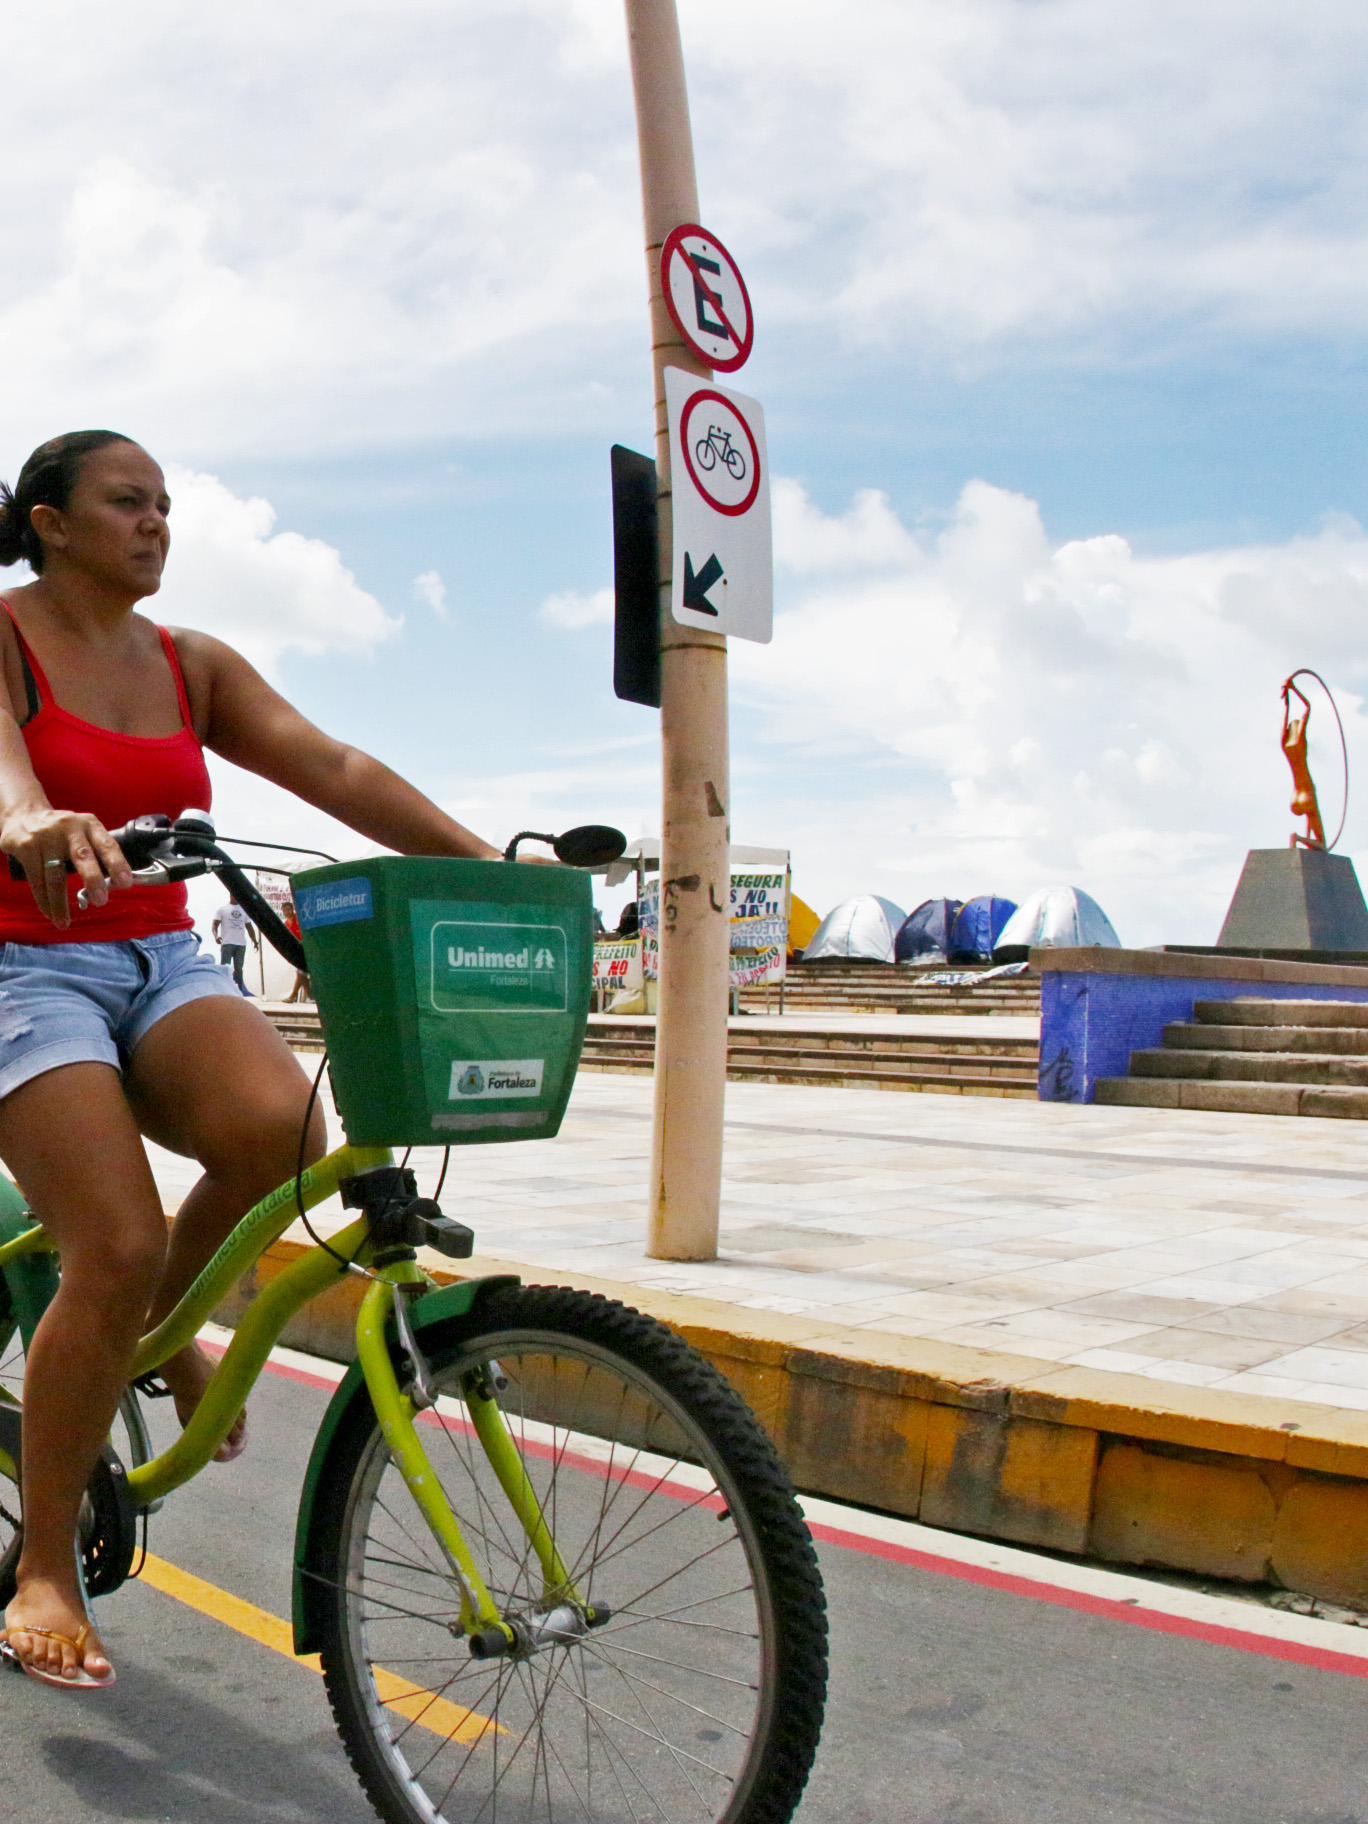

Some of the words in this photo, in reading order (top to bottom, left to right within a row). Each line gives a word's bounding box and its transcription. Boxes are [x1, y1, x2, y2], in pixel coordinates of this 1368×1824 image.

[689, 251, 730, 341] E
[730, 874, 783, 889] SEGURA
[316, 892, 367, 912] Bicicletar
[744, 889, 767, 904] NO
[448, 946, 529, 969] Unimed
[608, 959, 629, 976] NO
[488, 1077, 536, 1089] Fortaleza
